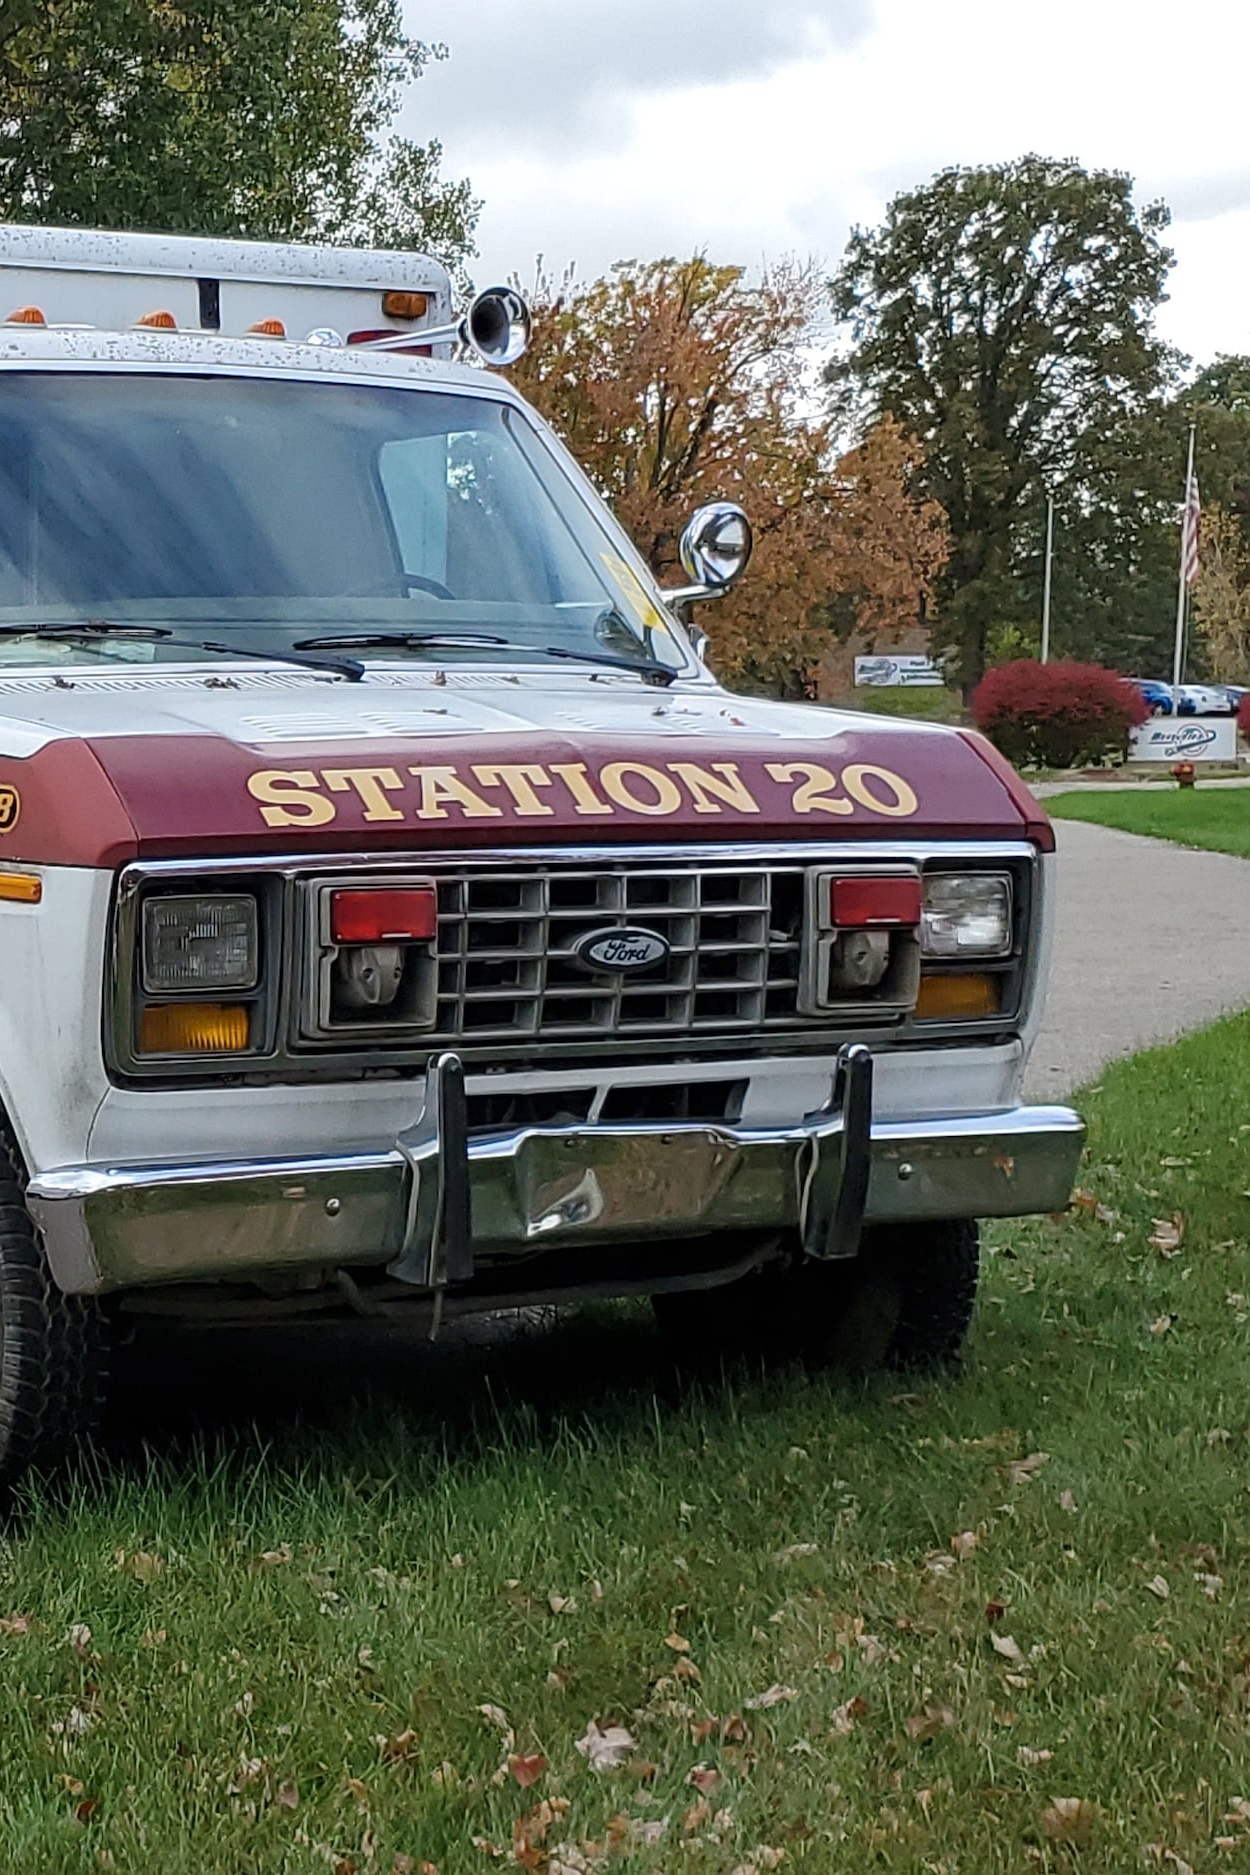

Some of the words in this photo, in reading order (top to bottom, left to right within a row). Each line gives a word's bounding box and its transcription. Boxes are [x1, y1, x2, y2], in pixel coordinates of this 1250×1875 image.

[246, 760, 762, 828] STATION
[762, 761, 919, 818] 20
[603, 938, 651, 961] Ford
